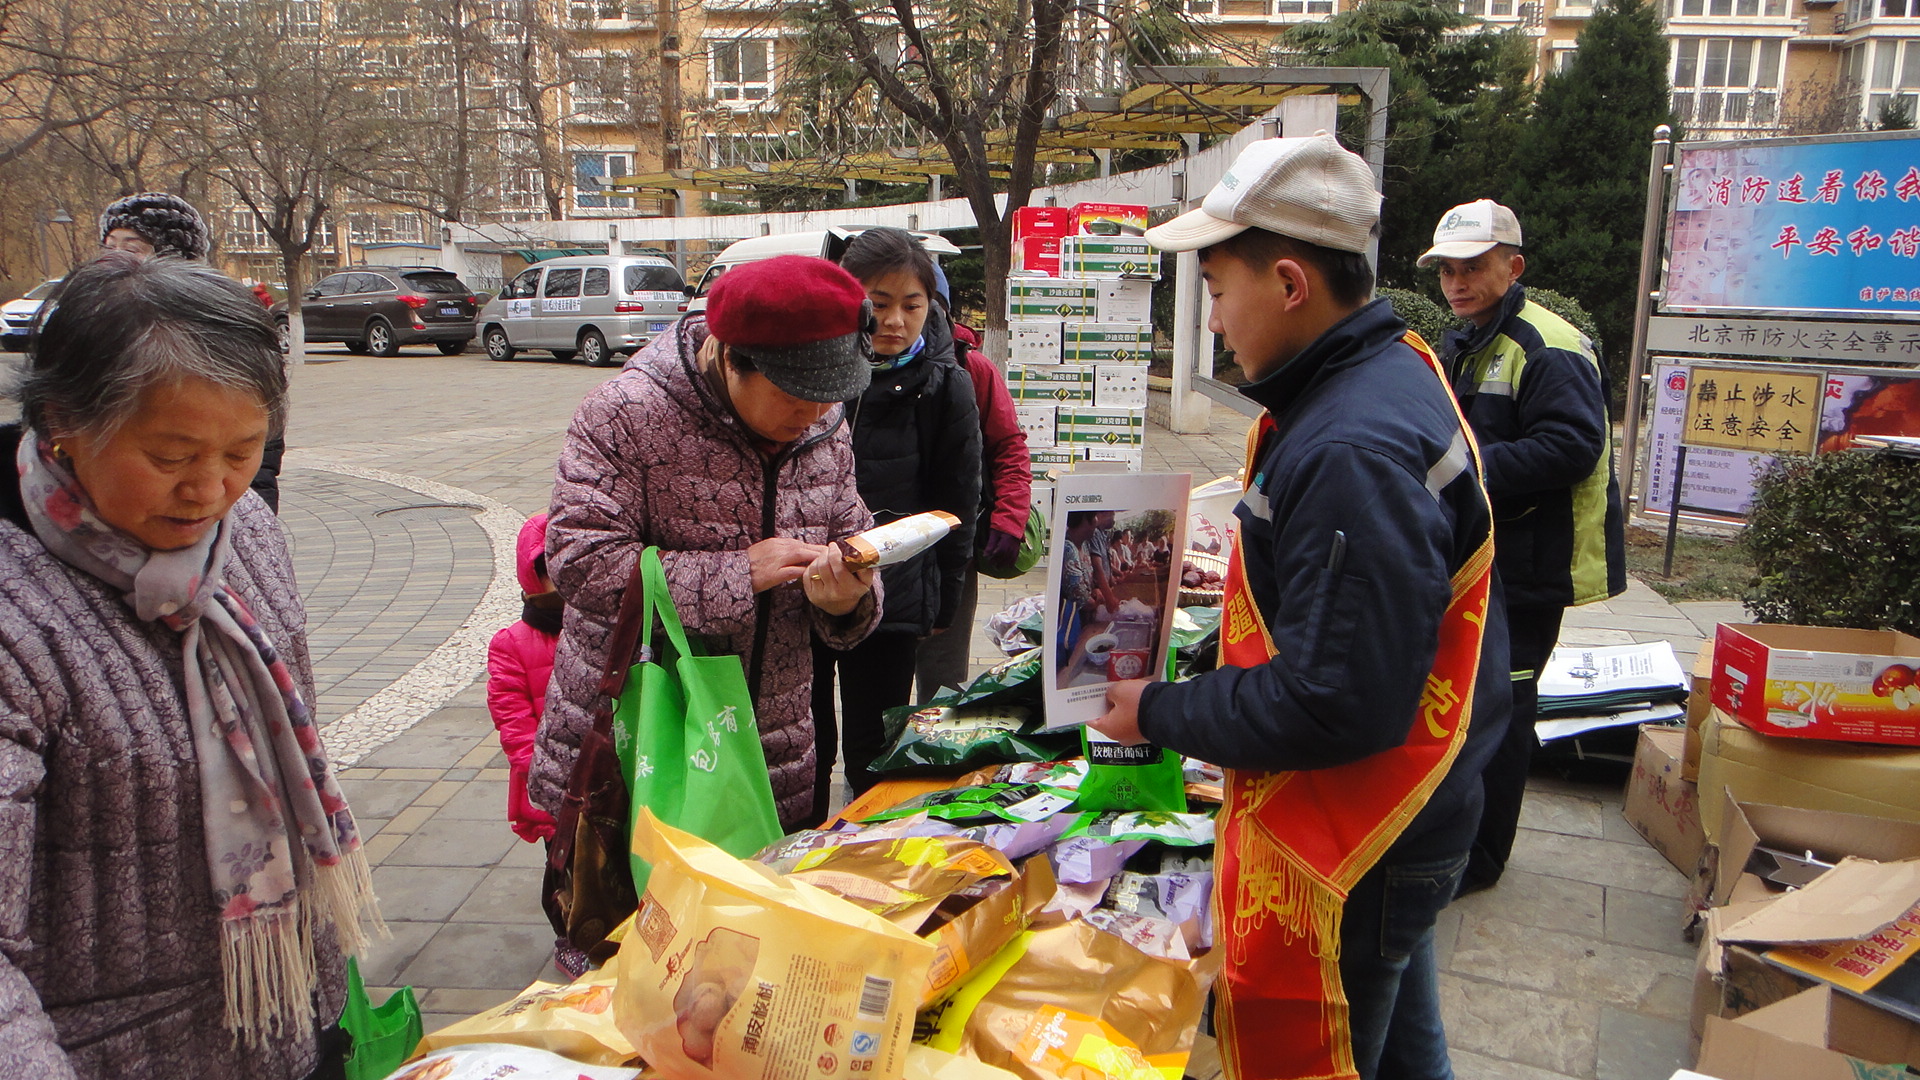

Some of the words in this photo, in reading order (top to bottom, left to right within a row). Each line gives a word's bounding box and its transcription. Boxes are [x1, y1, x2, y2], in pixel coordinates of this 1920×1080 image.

[1708, 167, 1920, 206] 消防连着你我
[1771, 225, 1920, 259] 平安和谐
[1688, 323, 1920, 354] 北京市防火安全警示
[1697, 379, 1805, 408] 禁止涉水
[1694, 413, 1802, 442] 注意安全
[1065, 495, 1081, 504] SDK
[1226, 588, 1257, 645] 疆
[1093, 746, 1151, 759] 玫瑰香葡萄干
[741, 981, 775, 1055] 薄皮核桃
